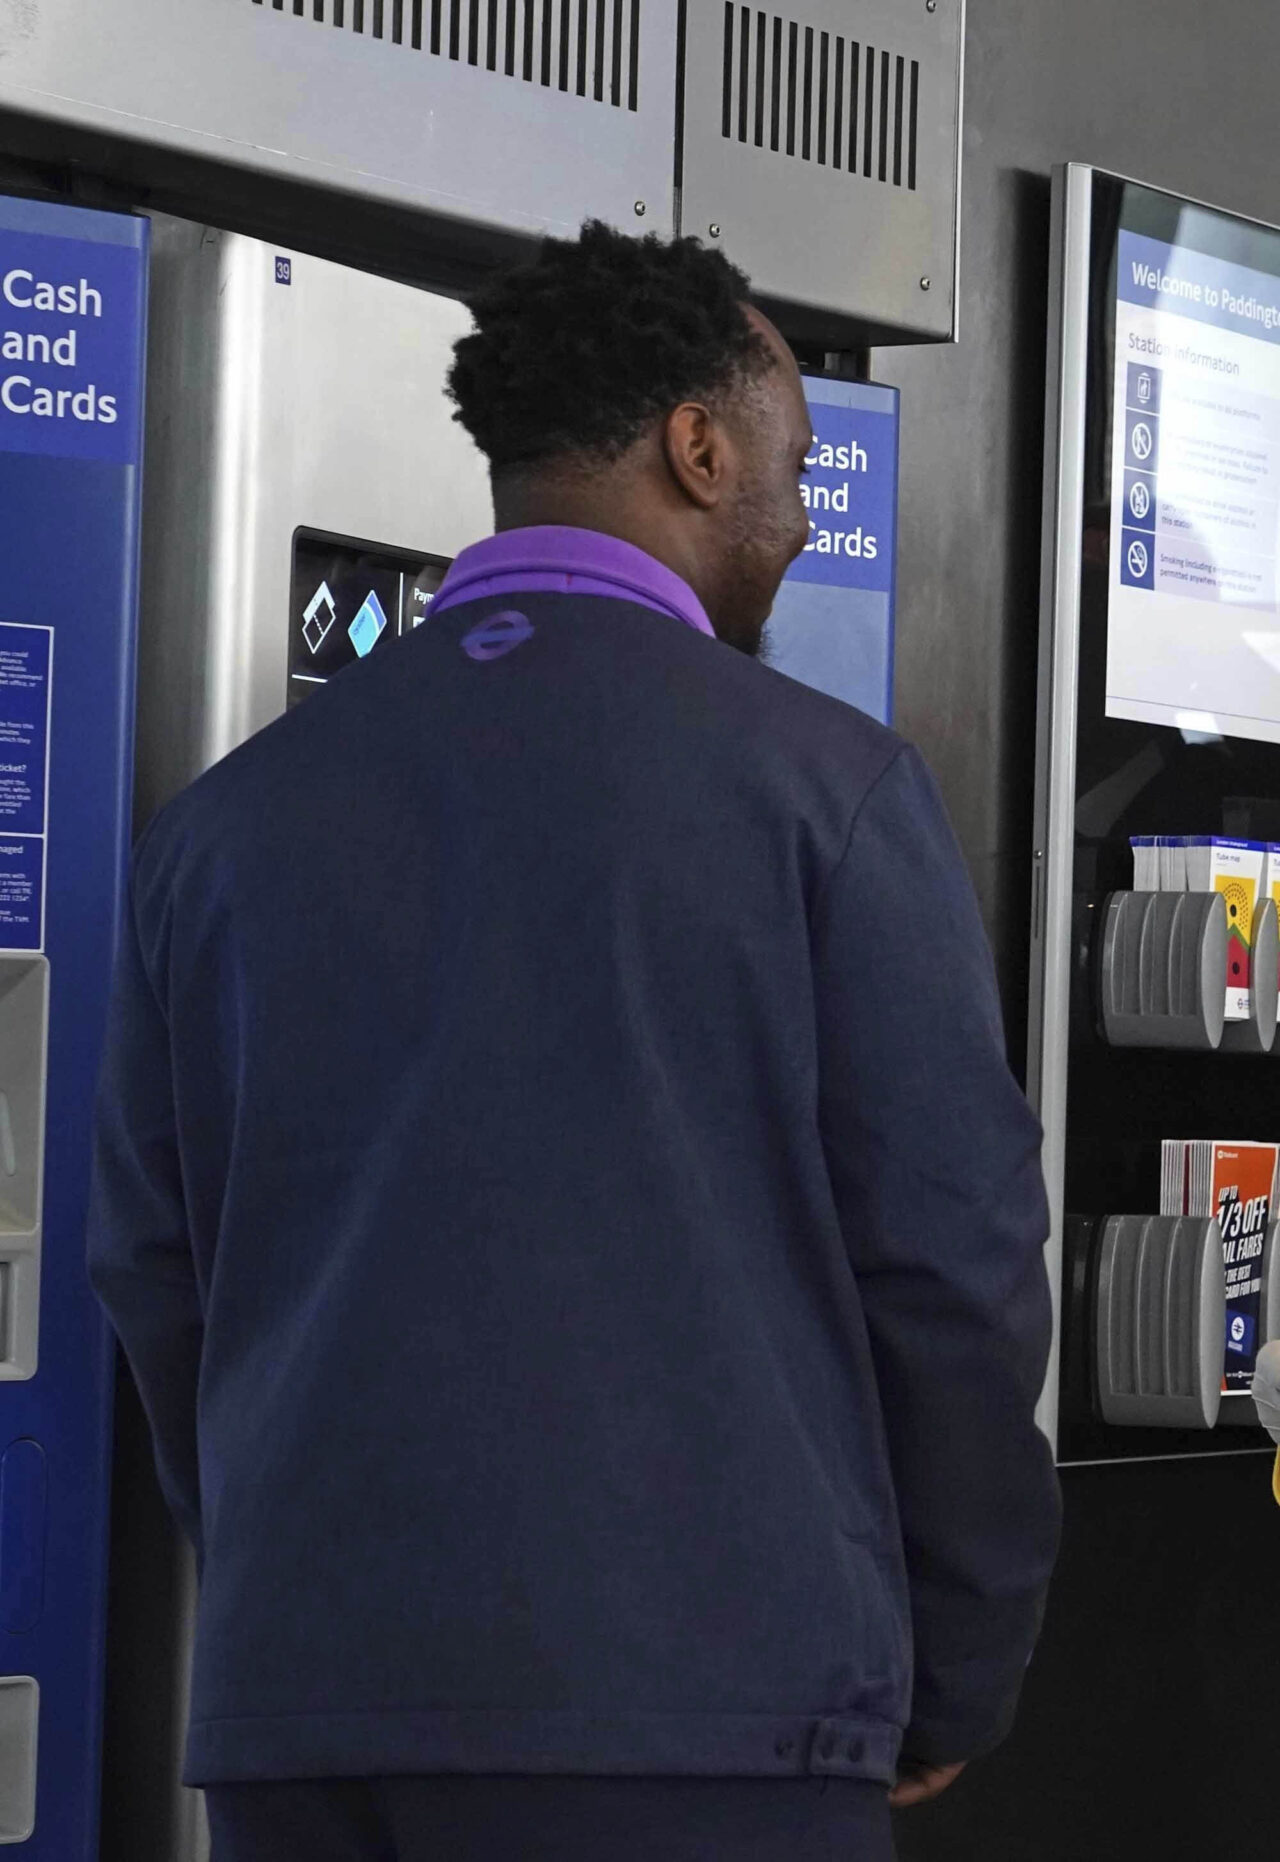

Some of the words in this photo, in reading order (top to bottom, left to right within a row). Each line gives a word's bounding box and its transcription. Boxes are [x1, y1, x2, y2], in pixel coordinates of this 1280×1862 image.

[276, 261, 290, 280] 39
[1132, 262, 1202, 301] Welcome
[1204, 284, 1218, 306] to
[3, 269, 102, 317] Cash
[2, 330, 77, 367] and
[1128, 332, 1168, 358] Station
[1172, 343, 1240, 376] information
[1, 376, 118, 423] Cards
[799, 482, 849, 512] and
[1216, 853, 1229, 861] Tube
[1218, 1187, 1230, 1202] UP
[1229, 1185, 1238, 1200] TO
[1216, 1201, 1243, 1239] 1/3
[1242, 1195, 1268, 1234] OFF
[1222, 1241, 1236, 1263] AIL
[1236, 1233, 1264, 1261] FARES
[1226, 1268, 1237, 1283] THE
[1237, 1264, 1252, 1281] BEST
[1225, 1283, 1240, 1299] CARD
